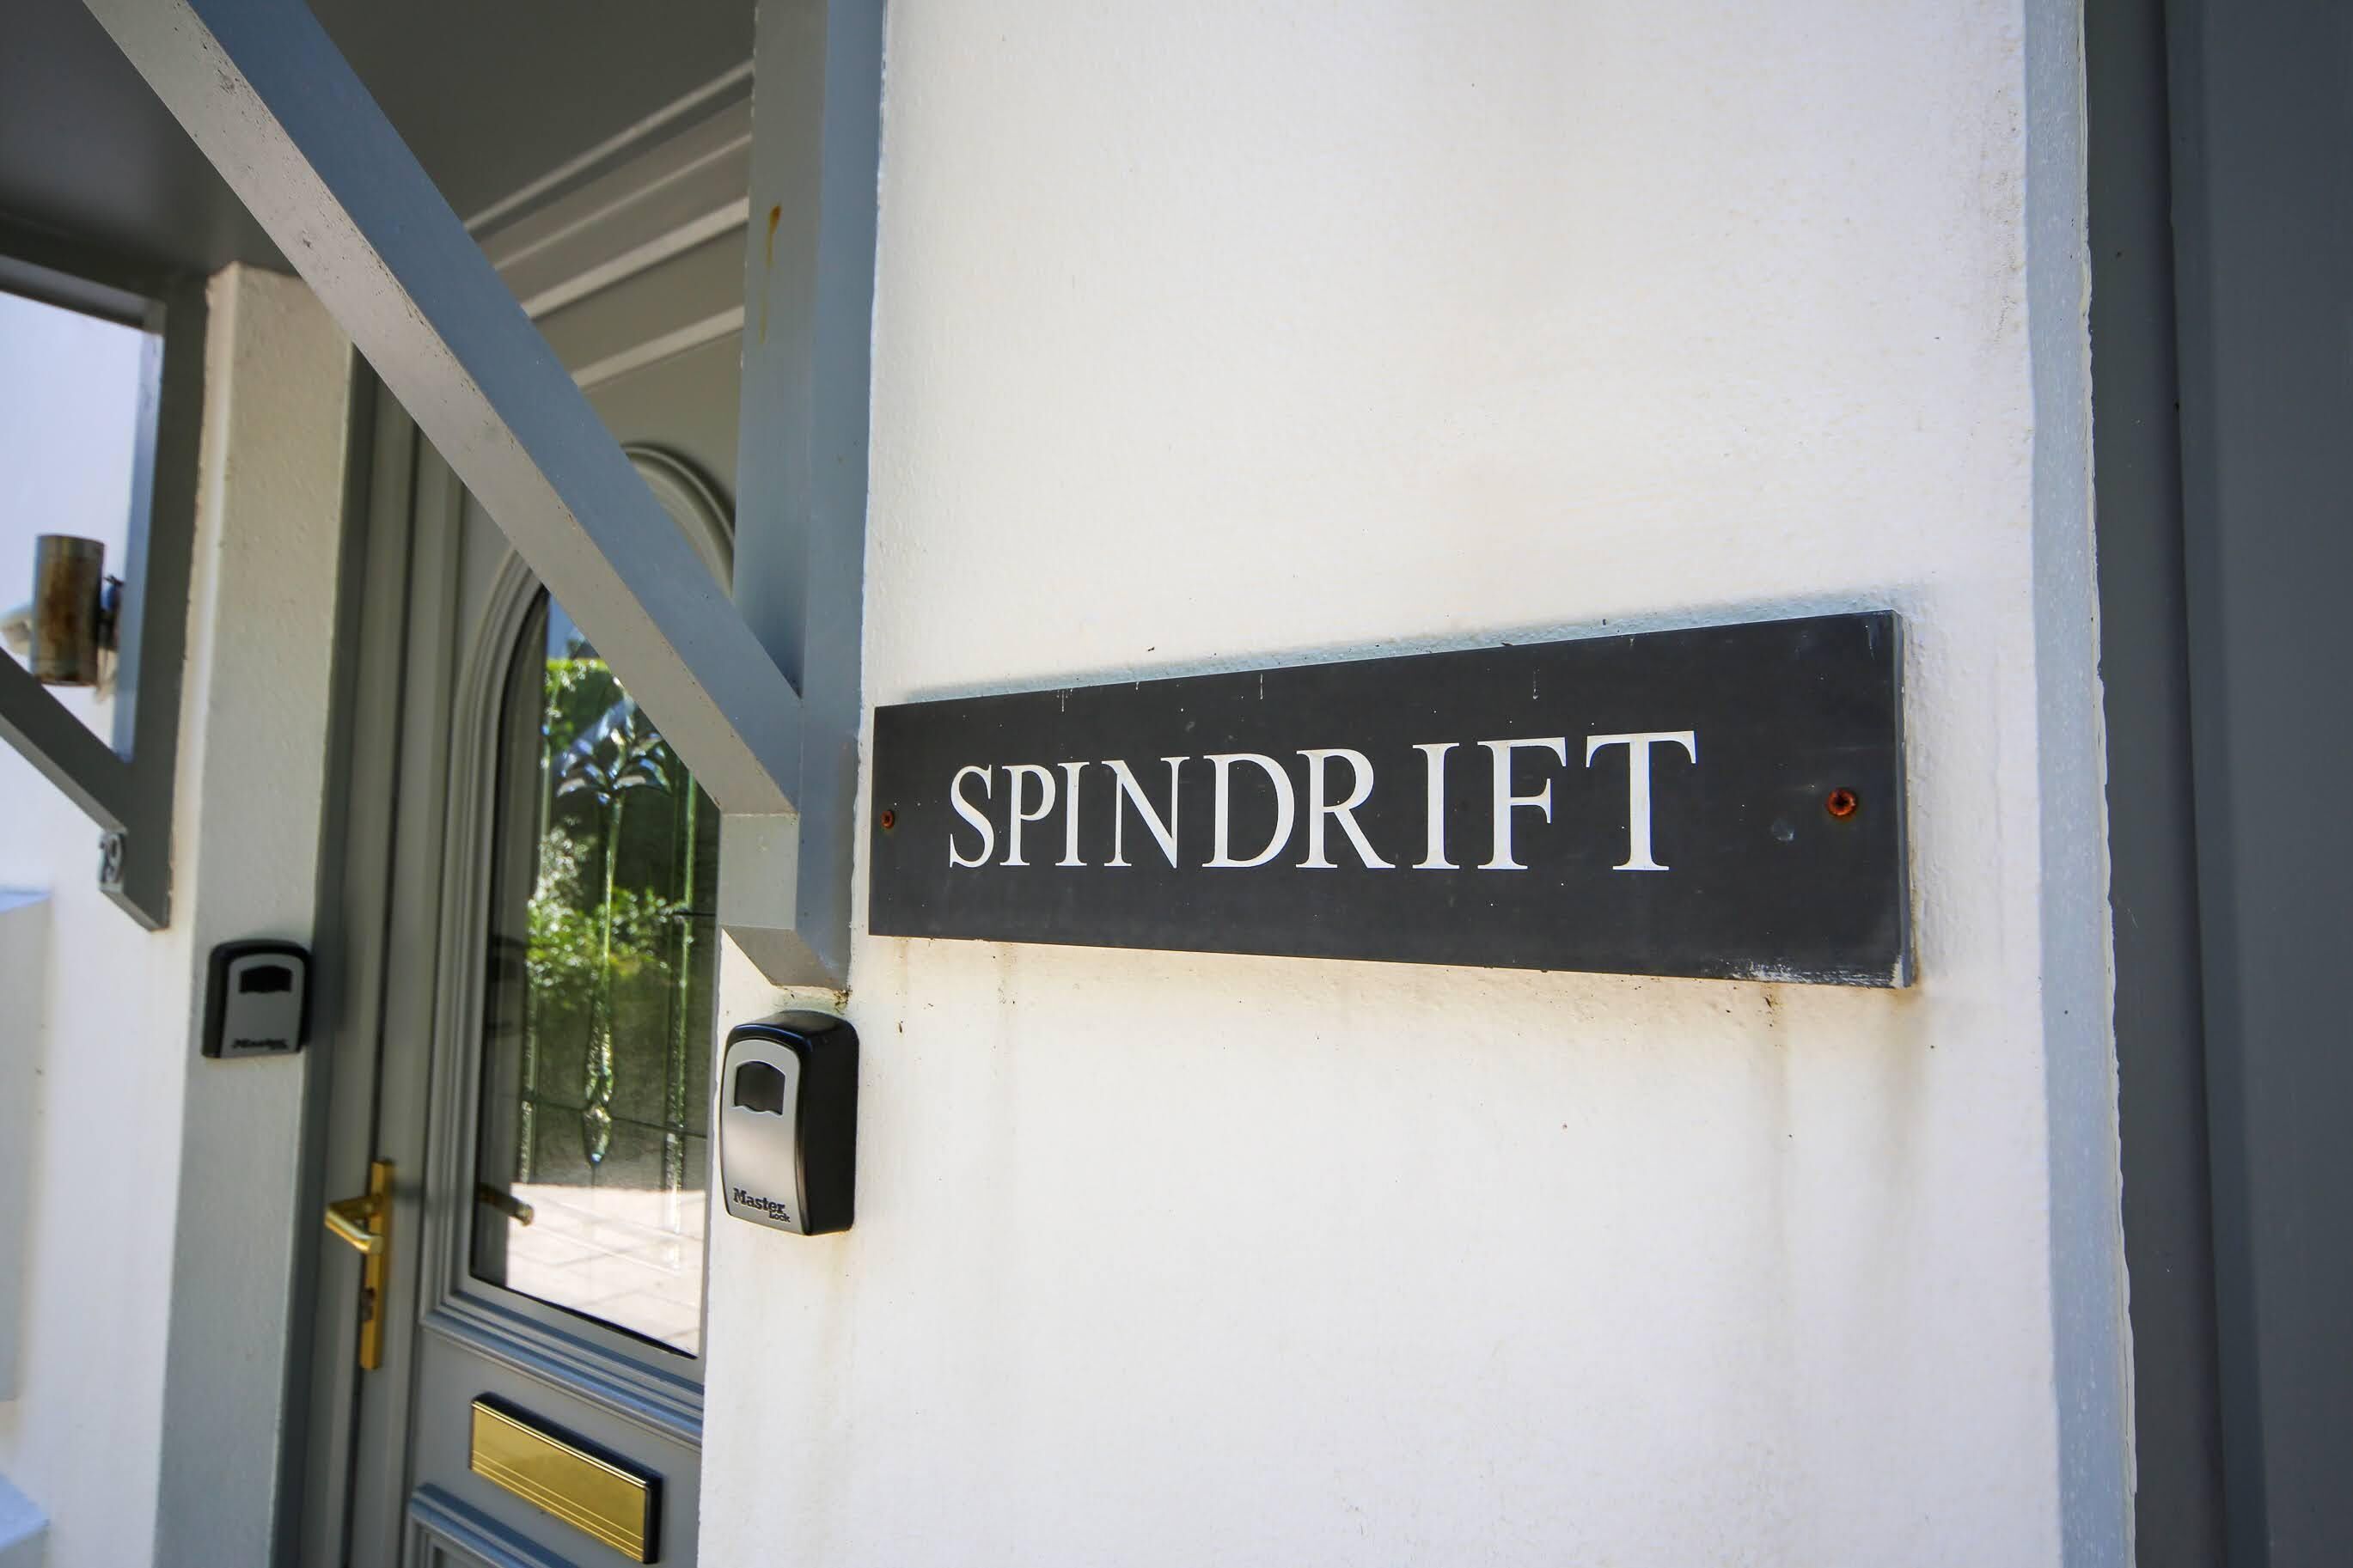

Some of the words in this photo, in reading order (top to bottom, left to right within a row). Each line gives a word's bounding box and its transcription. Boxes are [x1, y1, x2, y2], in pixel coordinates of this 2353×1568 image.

[949, 730, 1696, 871] SPINDRIFT
[733, 1187, 785, 1214] Master
[768, 1210, 791, 1223] Lock
